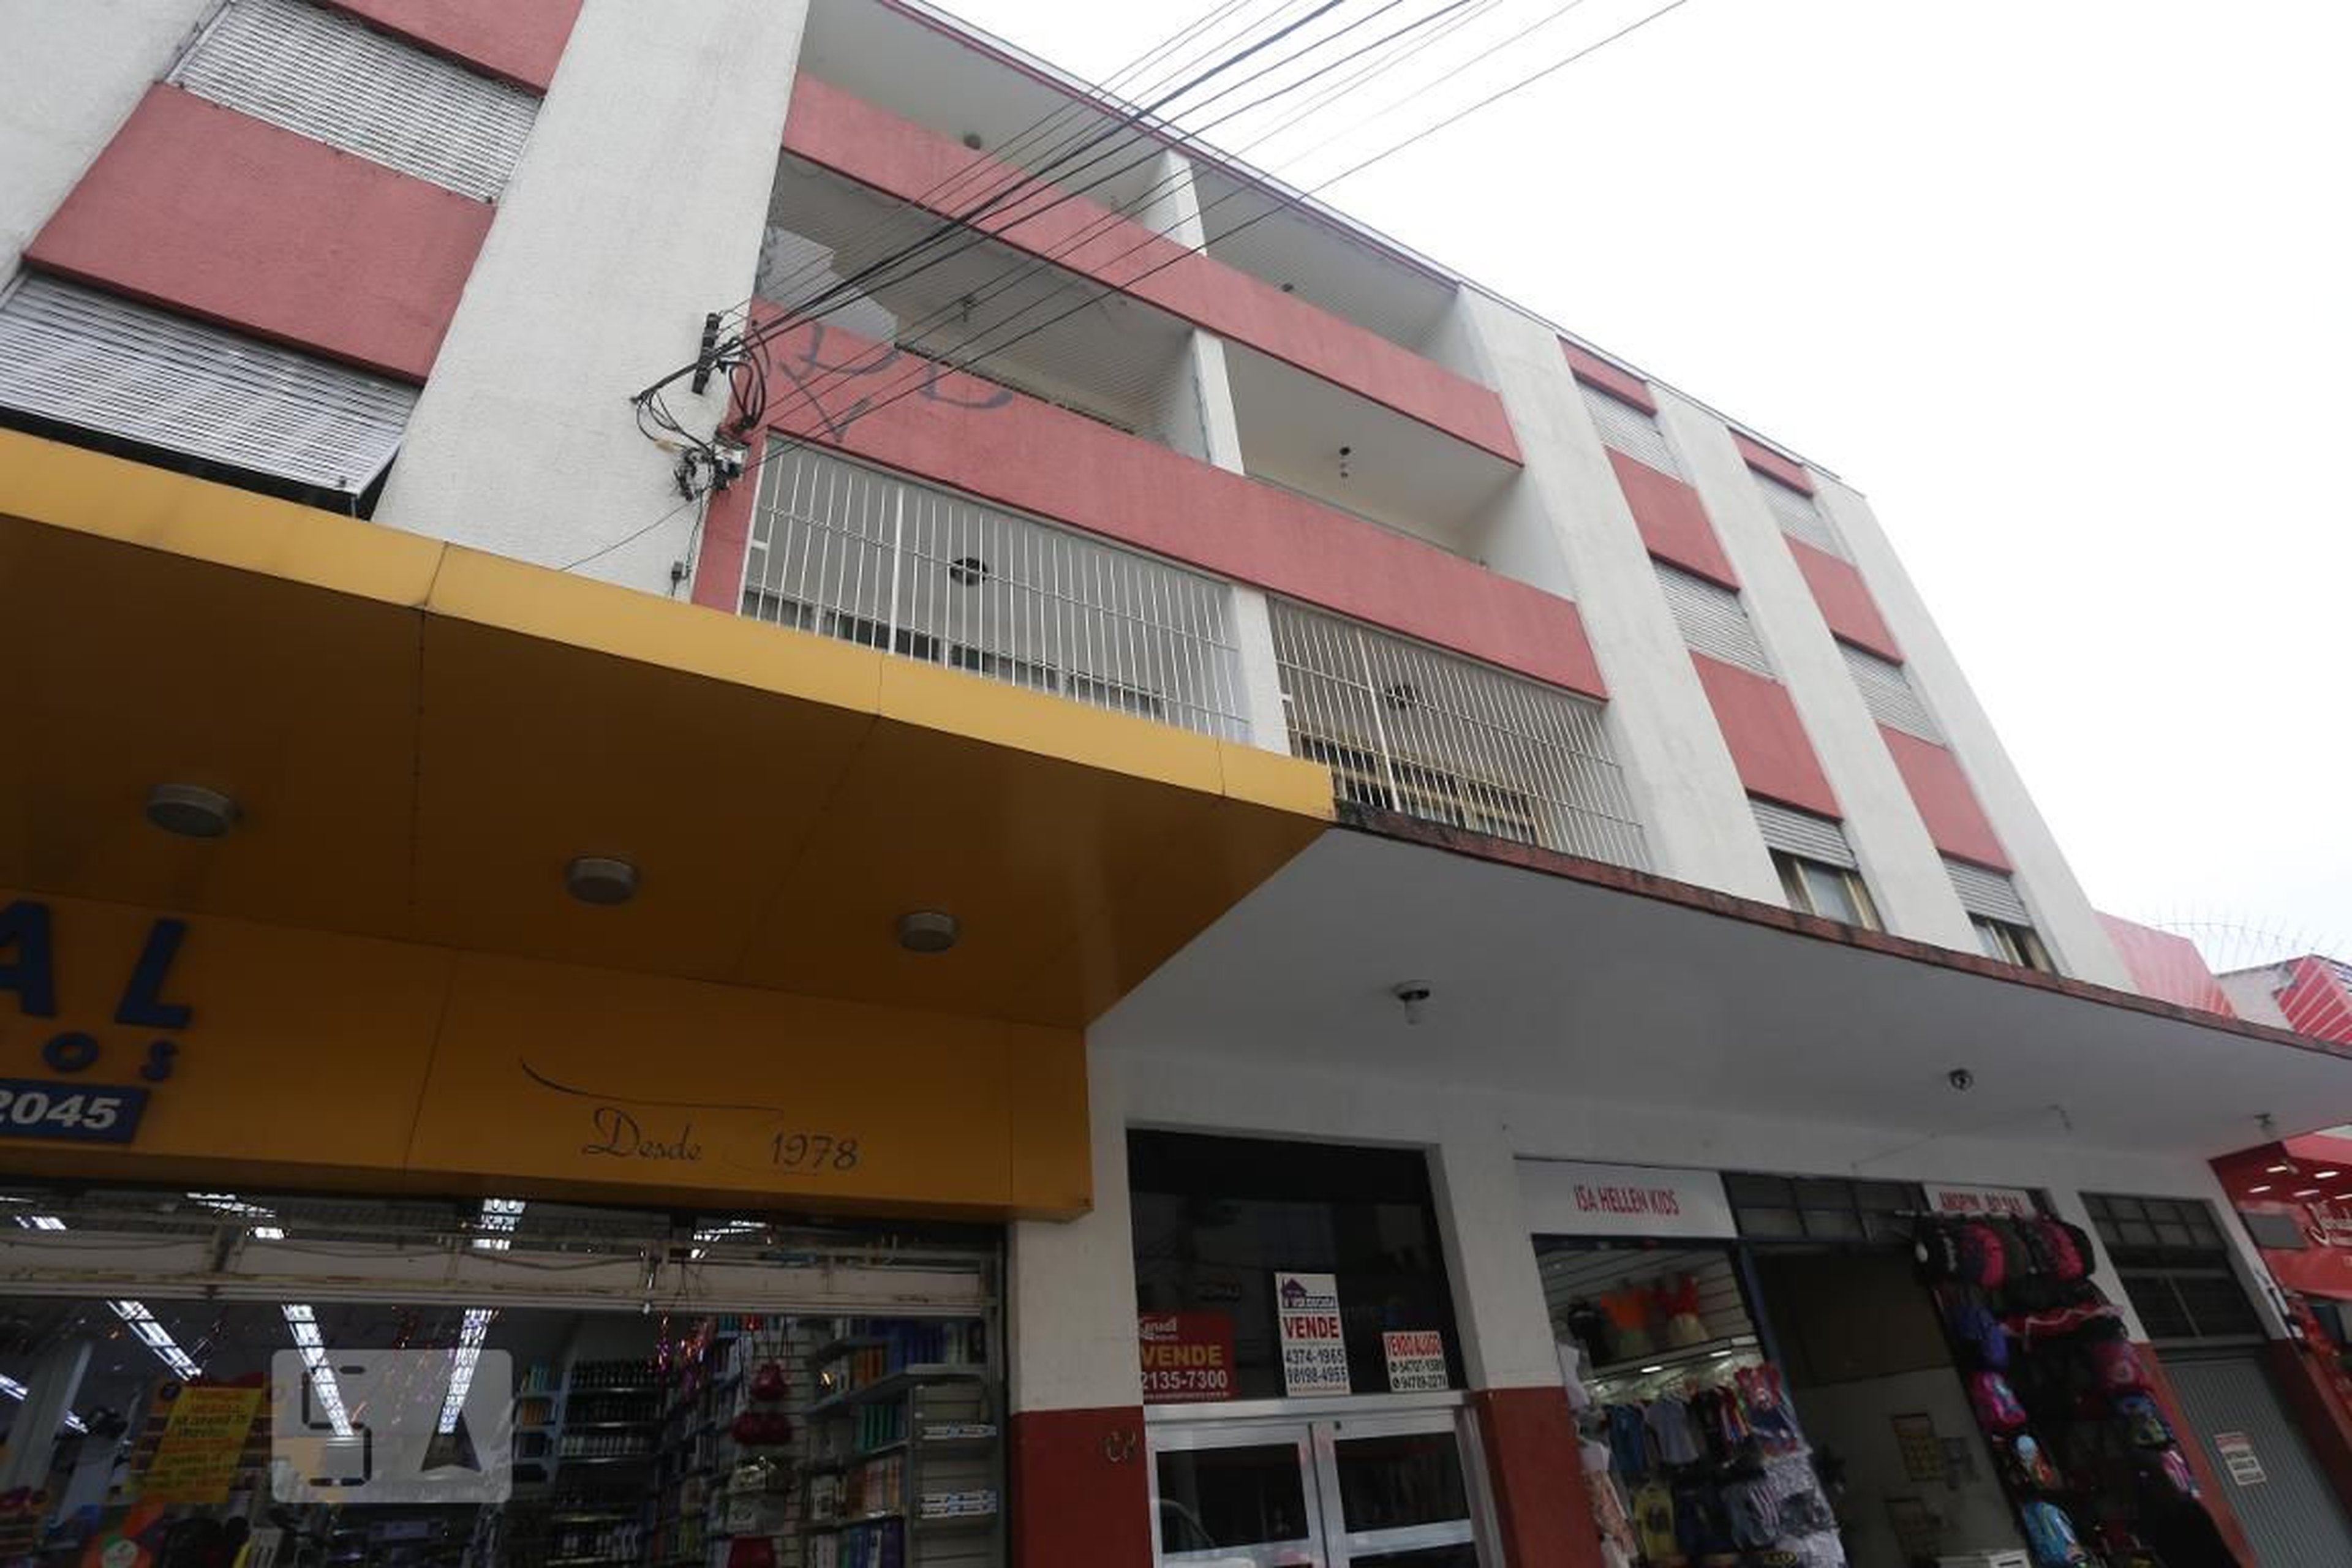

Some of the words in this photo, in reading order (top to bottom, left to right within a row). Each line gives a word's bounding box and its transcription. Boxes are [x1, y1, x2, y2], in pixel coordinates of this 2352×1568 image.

[581, 1106, 702, 1161] Desde
[770, 1132, 859, 1170] 1978
[1283, 1316, 1340, 1339] VENDE
[1141, 1343, 1224, 1367] VENDE
[1141, 1368, 1229, 1390] 2135-7300
